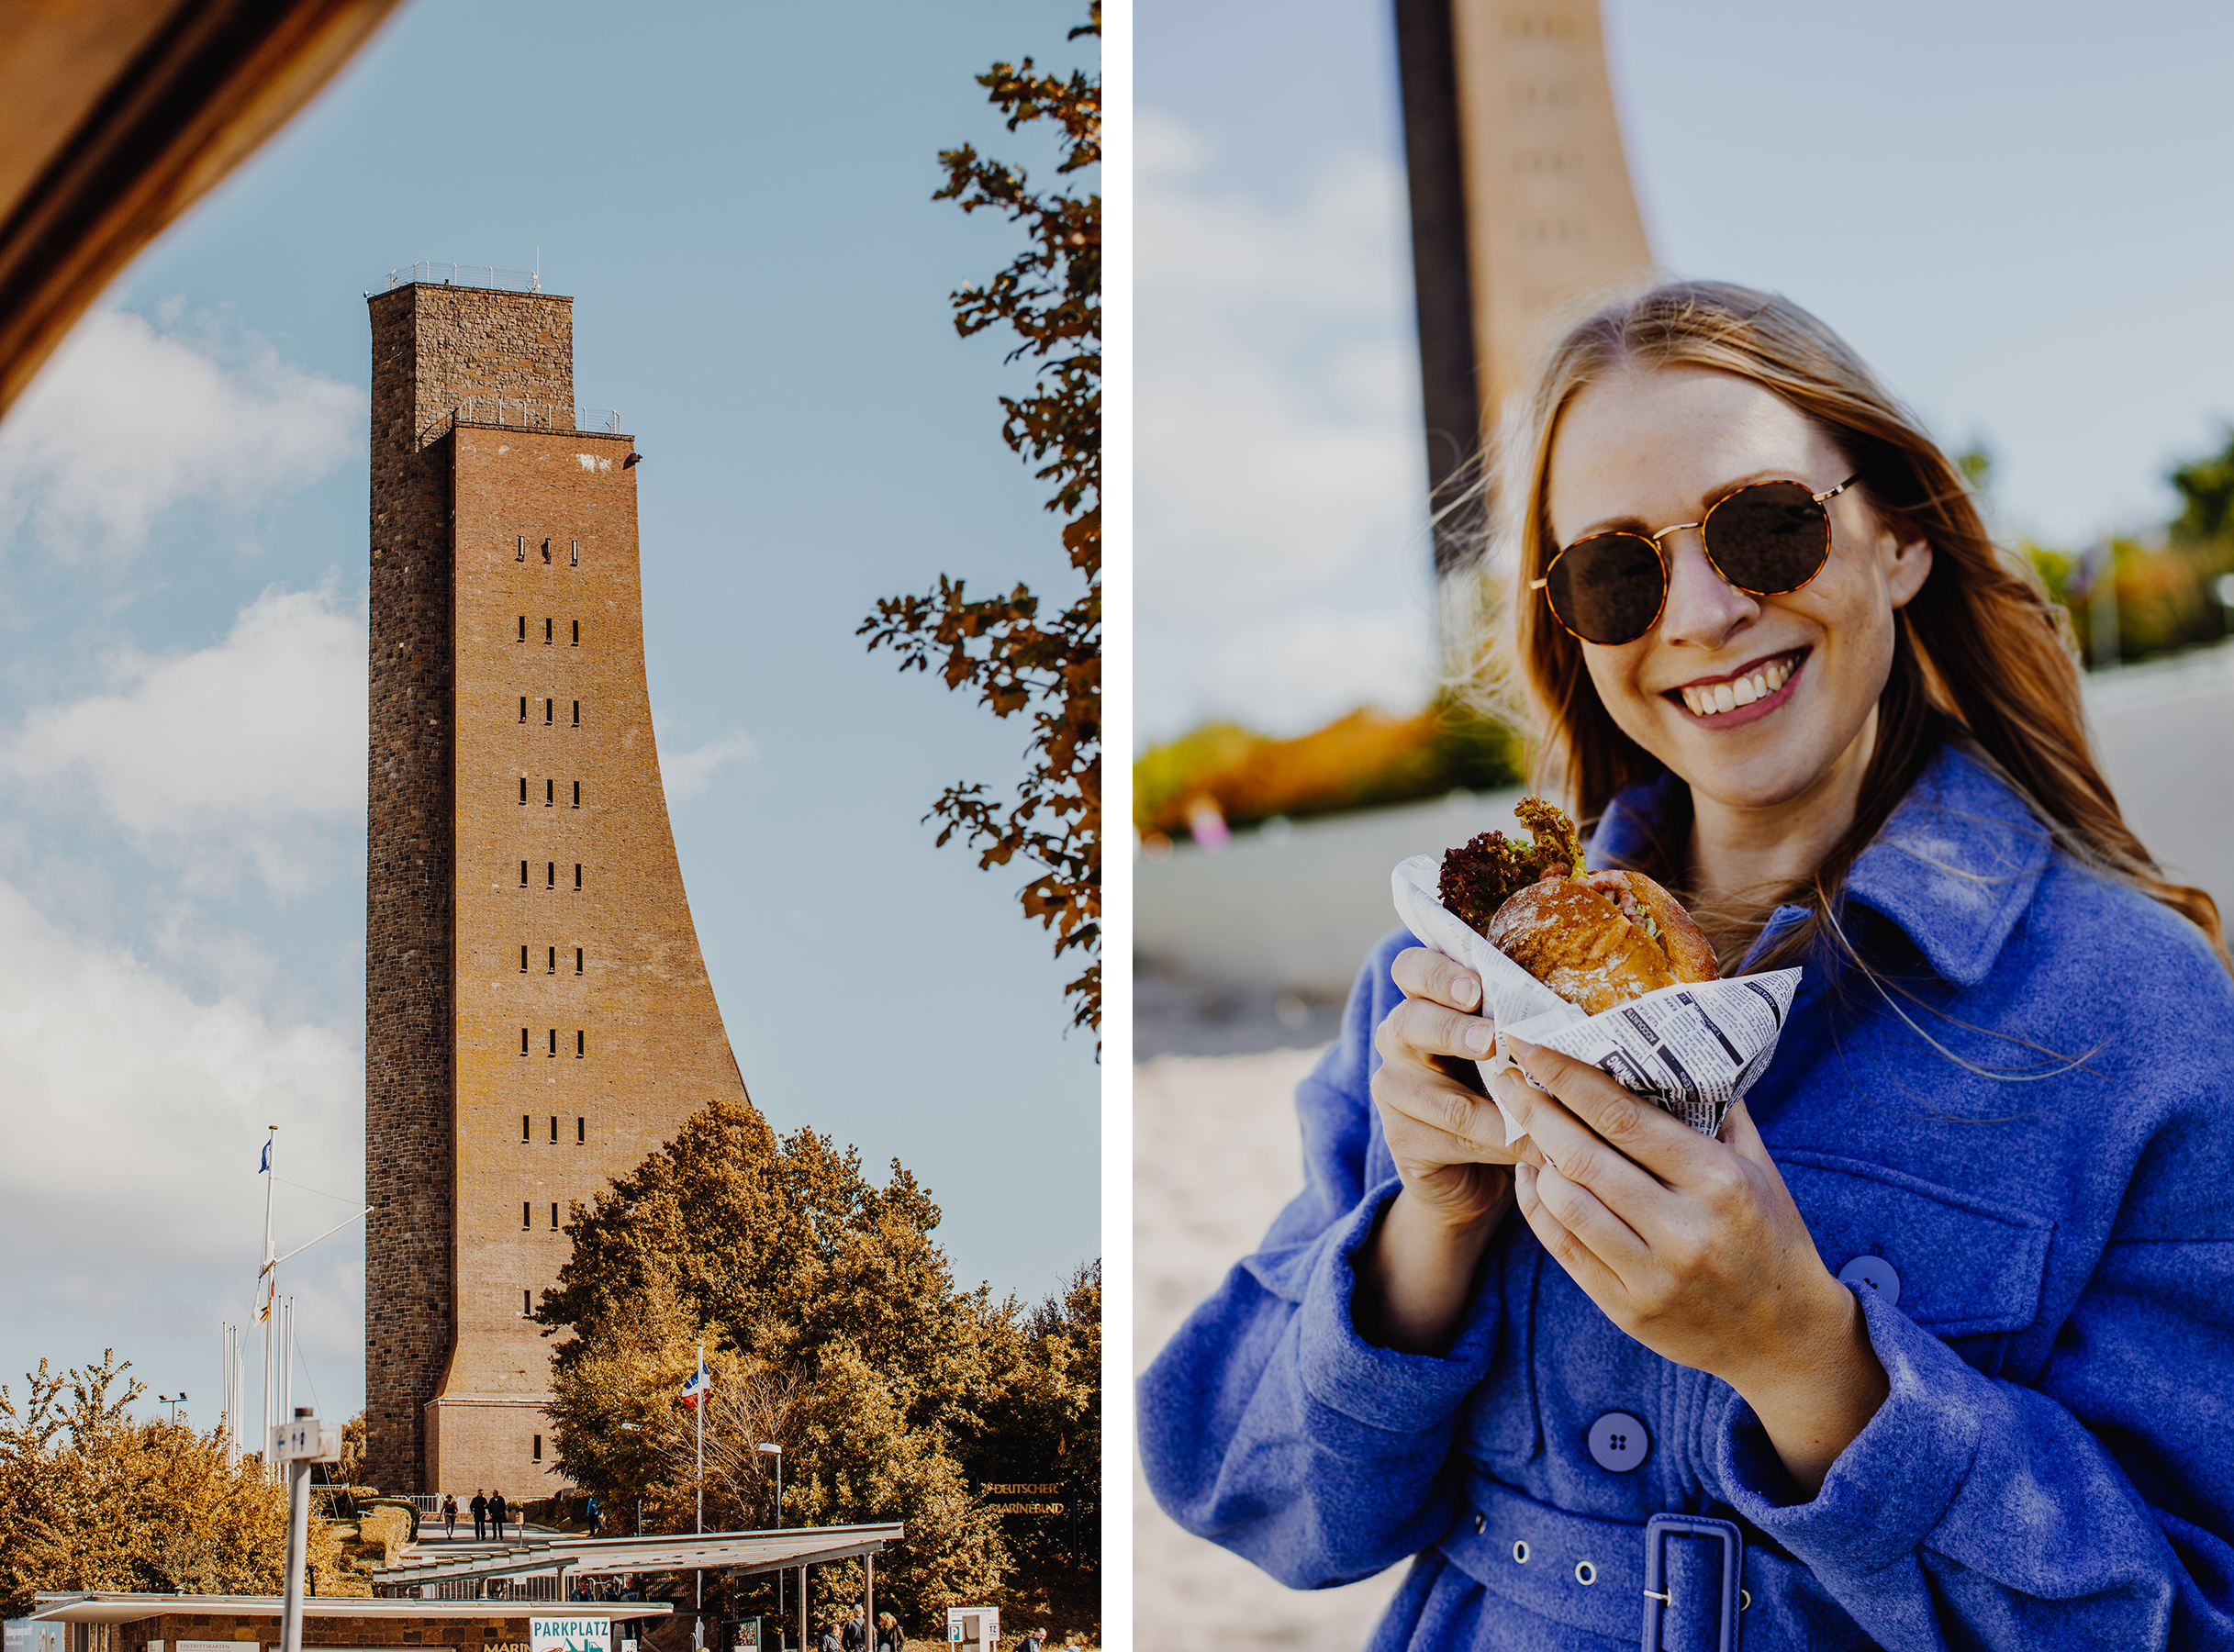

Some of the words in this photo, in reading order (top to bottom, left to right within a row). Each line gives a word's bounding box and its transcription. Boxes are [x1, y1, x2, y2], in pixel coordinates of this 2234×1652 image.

[1625, 1010, 1657, 1044] ACCOUNTS
[994, 1483, 1058, 1494] DEUTSCHER
[989, 1503, 1065, 1514] MARINEBUND
[534, 1622, 609, 1636] PARKPLATZ
